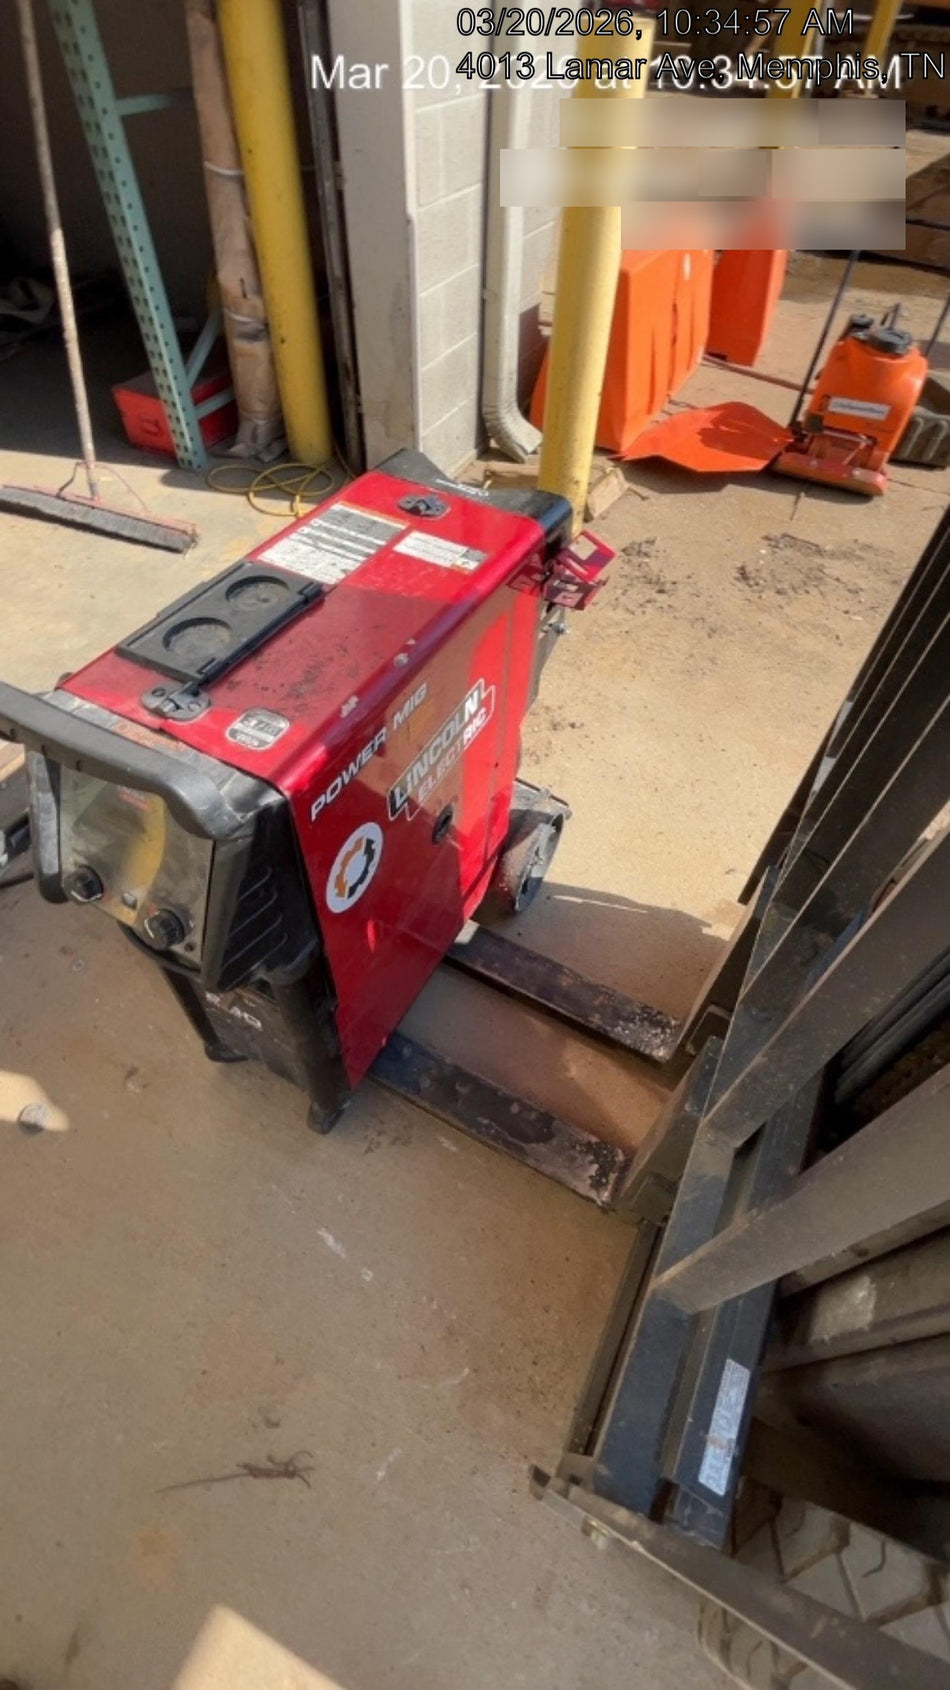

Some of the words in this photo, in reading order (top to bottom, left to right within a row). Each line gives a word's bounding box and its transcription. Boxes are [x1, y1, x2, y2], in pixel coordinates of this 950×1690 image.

[311, 726, 388, 822] POWER
[393, 683, 427, 731] MIG
[393, 688, 480, 810] LINCOLN
[418, 707, 487, 804] ELECTRIC
